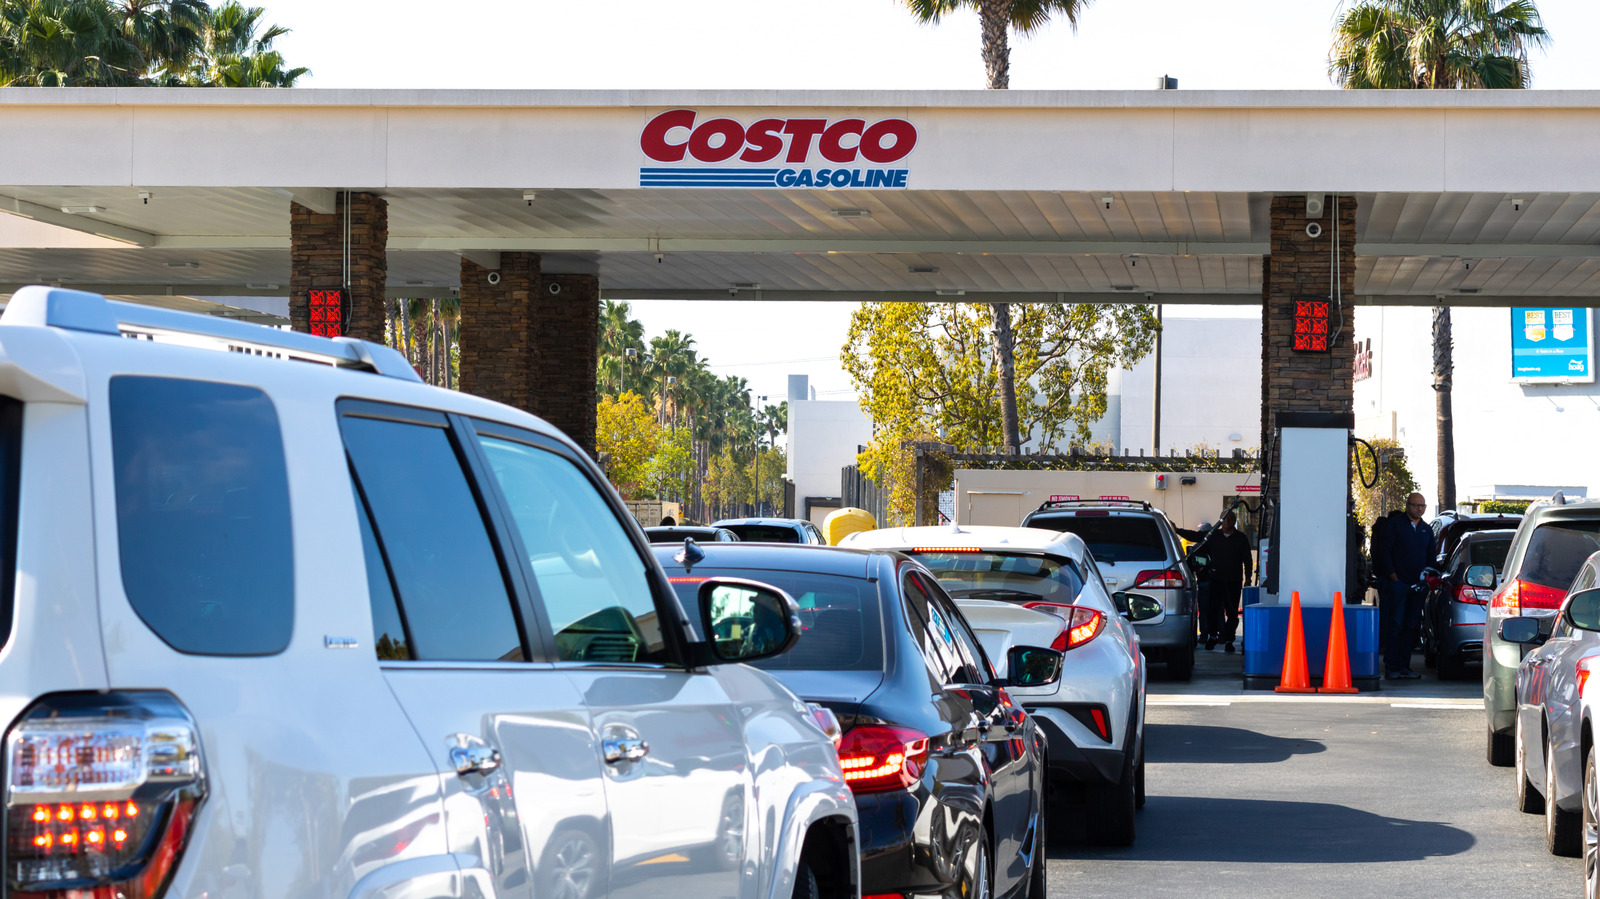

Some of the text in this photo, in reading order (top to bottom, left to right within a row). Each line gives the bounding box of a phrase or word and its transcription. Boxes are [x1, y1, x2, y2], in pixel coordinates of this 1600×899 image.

[640, 109, 918, 163] COSTCO
[775, 168, 909, 188] GASOLINE
[1554, 311, 1571, 319] BEST
[1568, 362, 1584, 372] hoag
